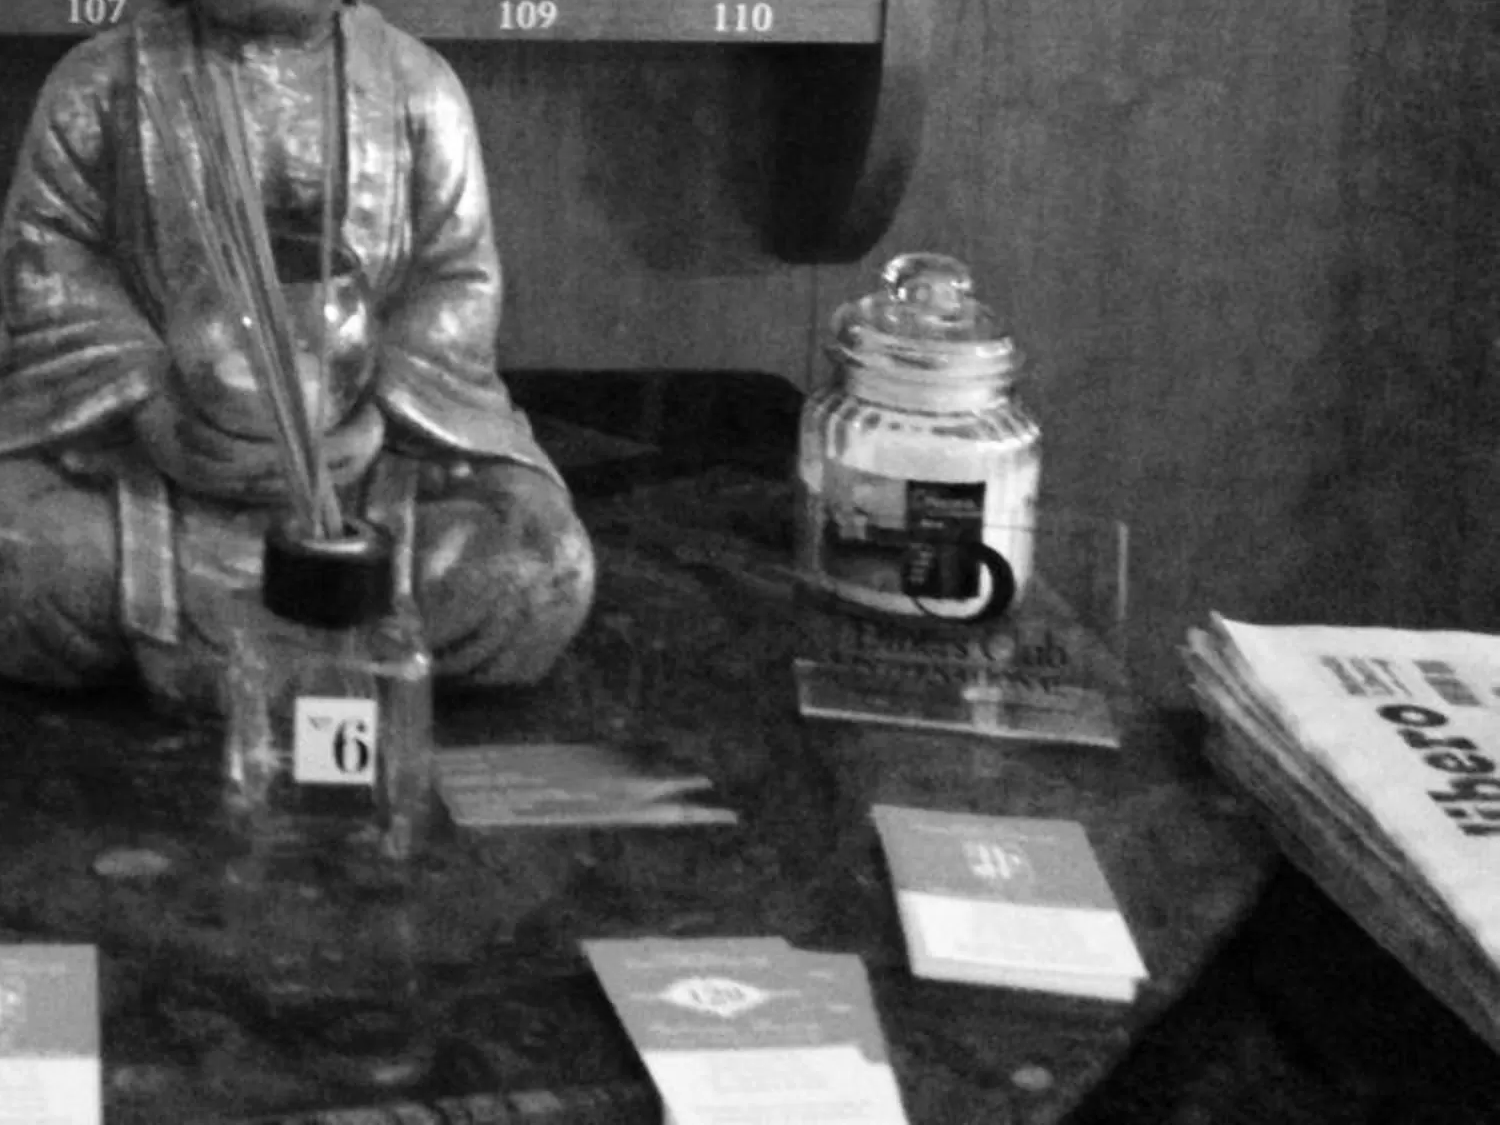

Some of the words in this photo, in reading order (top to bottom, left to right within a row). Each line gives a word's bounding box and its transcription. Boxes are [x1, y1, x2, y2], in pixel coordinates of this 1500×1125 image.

[501, 0, 558, 29] 109
[715, 2, 773, 32] 110
[332, 718, 369, 774] 6
